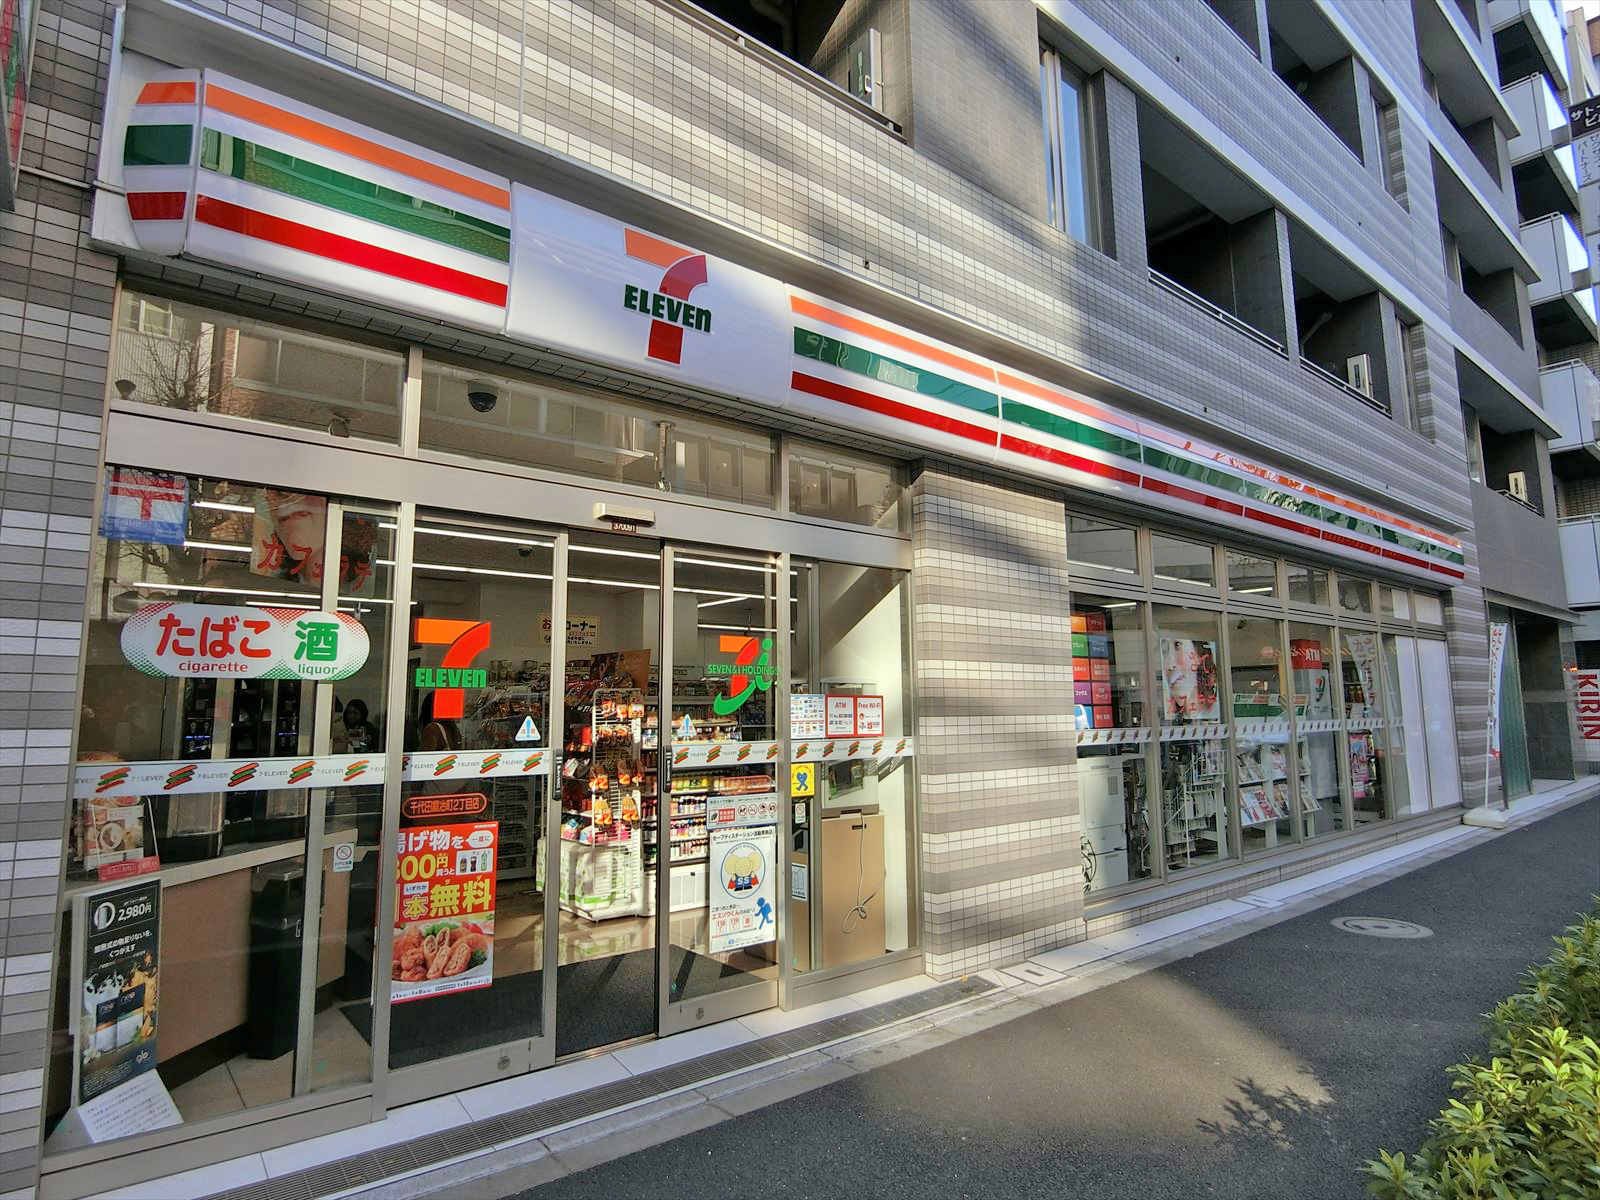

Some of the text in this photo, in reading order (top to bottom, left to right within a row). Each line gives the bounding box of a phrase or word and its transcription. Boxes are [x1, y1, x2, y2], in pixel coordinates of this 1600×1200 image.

[543, 618, 596, 631] おコーナー
[156, 613, 340, 662] たばこ 酒
[1305, 648, 1321, 661] ATM
[179, 661, 339, 675] cigarette liquor
[742, 665, 781, 675] HOLDINGS
[1577, 674, 1600, 739] KIRIN
[737, 877, 750, 885] SS
